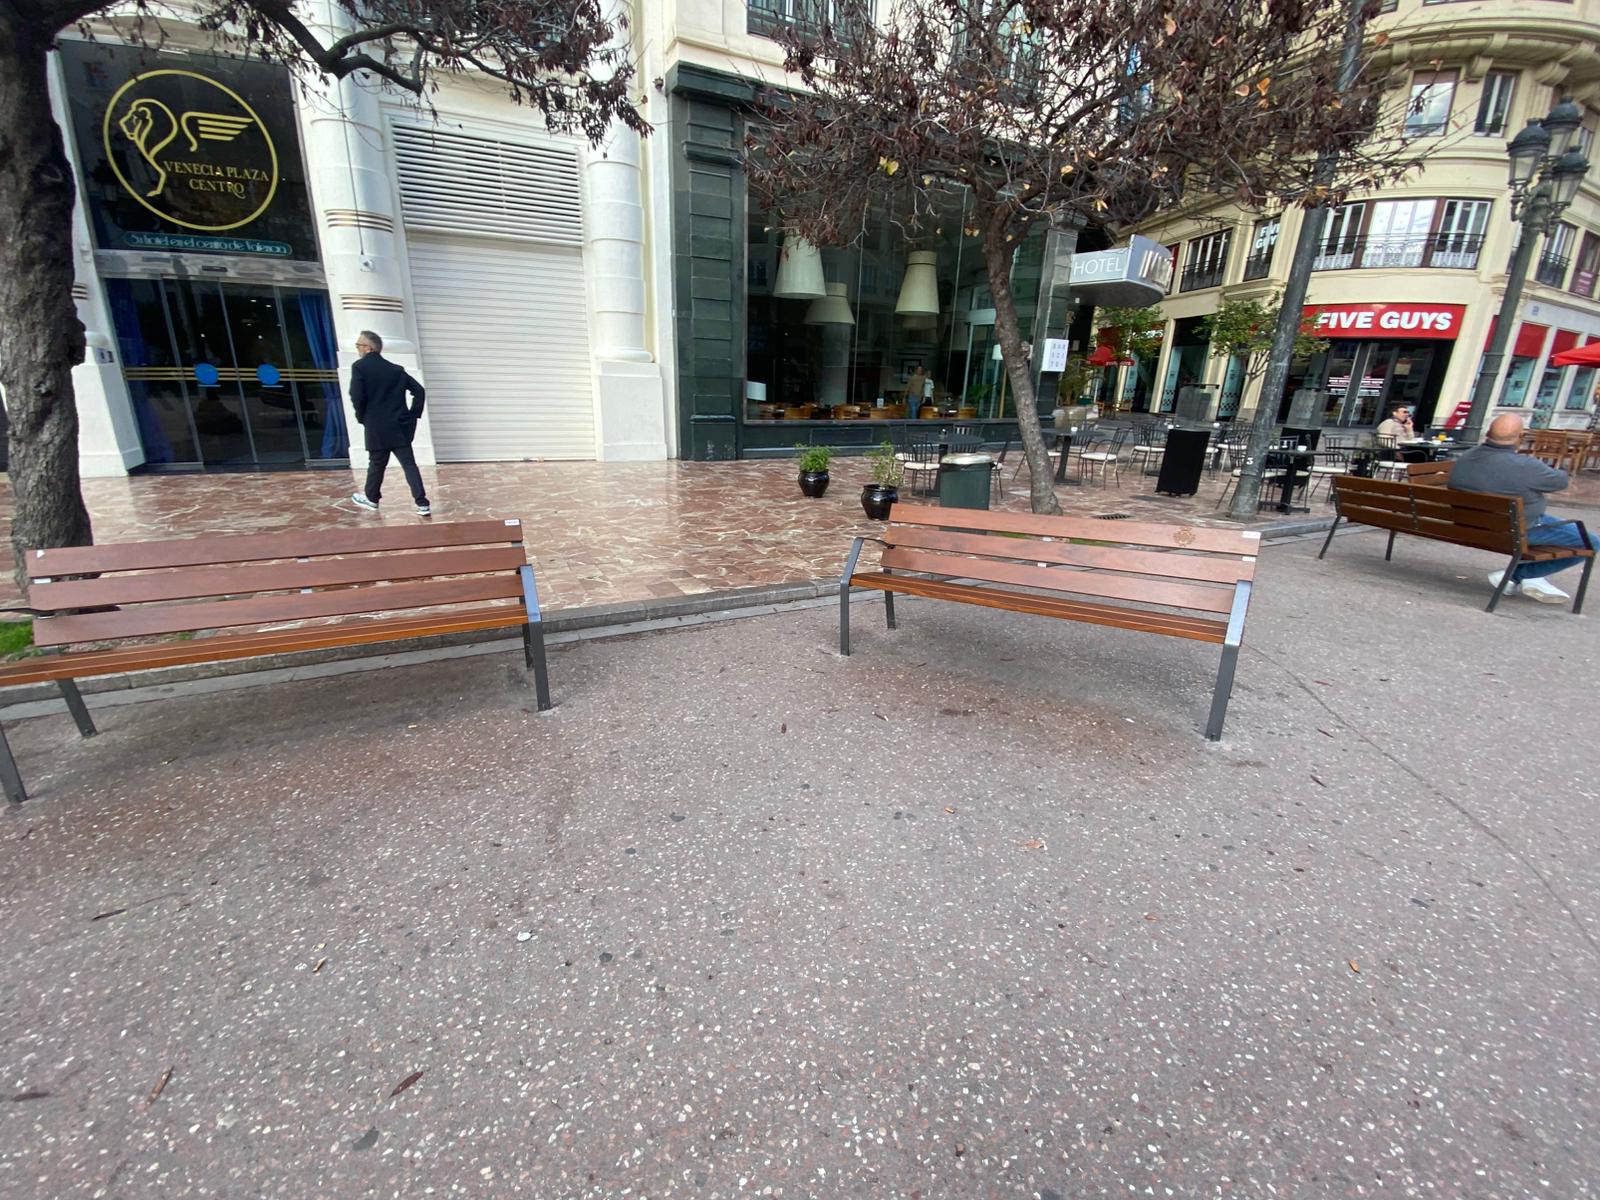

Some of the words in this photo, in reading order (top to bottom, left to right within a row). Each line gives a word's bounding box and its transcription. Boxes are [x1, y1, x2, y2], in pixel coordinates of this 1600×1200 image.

[163, 160, 224, 177] VENECIA
[225, 166, 269, 181] PLAZA
[189, 178, 246, 199] CENTRO
[1073, 257, 1123, 276] HOTEL
[1314, 311, 1374, 329] FIVE
[1379, 311, 1453, 331] GUYS
